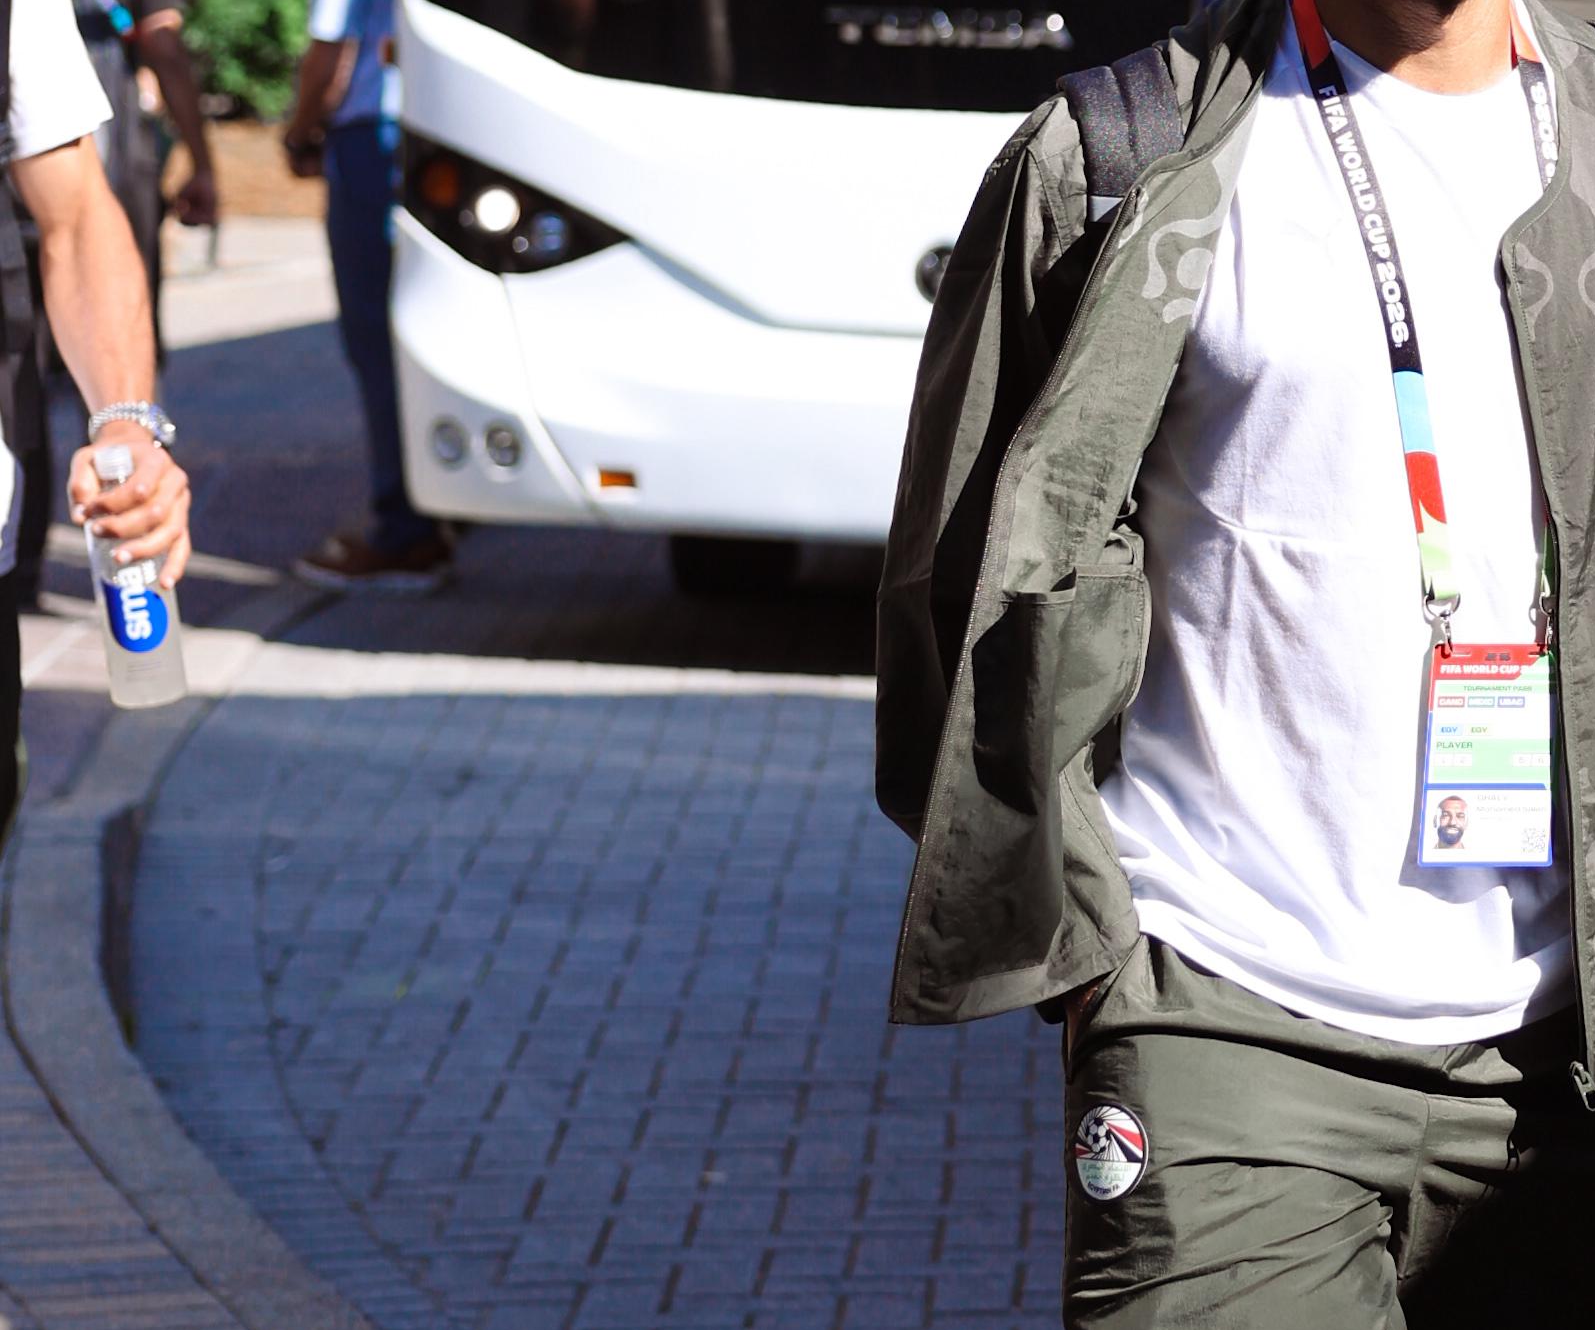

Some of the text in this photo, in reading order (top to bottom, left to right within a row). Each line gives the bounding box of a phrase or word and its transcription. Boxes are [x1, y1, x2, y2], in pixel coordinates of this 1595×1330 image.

[1318, 85, 1347, 133] FIFA
[1335, 132, 1376, 211] WORLD
[1363, 212, 1391, 259] CUP
[1440, 664, 1461, 674] FIFA
[1463, 664, 1498, 674] WORLD
[1499, 664, 1519, 674] CUP
[1436, 741, 1472, 749] PLAYER
